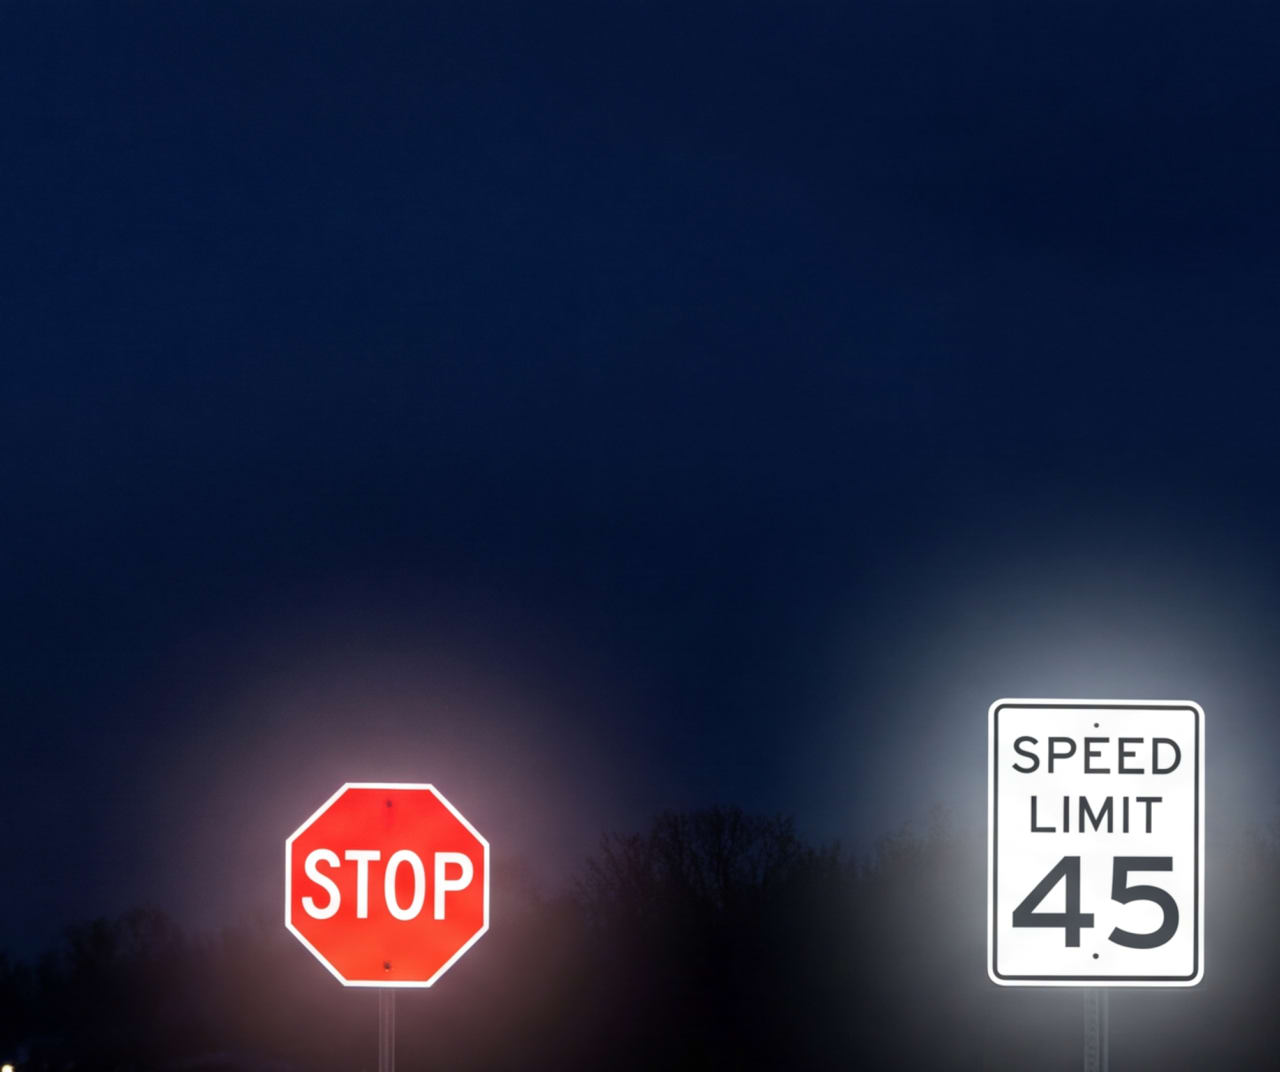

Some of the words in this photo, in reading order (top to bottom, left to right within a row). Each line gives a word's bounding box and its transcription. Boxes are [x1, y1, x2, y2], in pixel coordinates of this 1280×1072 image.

[1012, 736, 1182, 775] SPEED
[1030, 795, 1163, 833] LIMIT
[301, 848, 474, 921] STOP
[1012, 855, 1180, 950] 45
